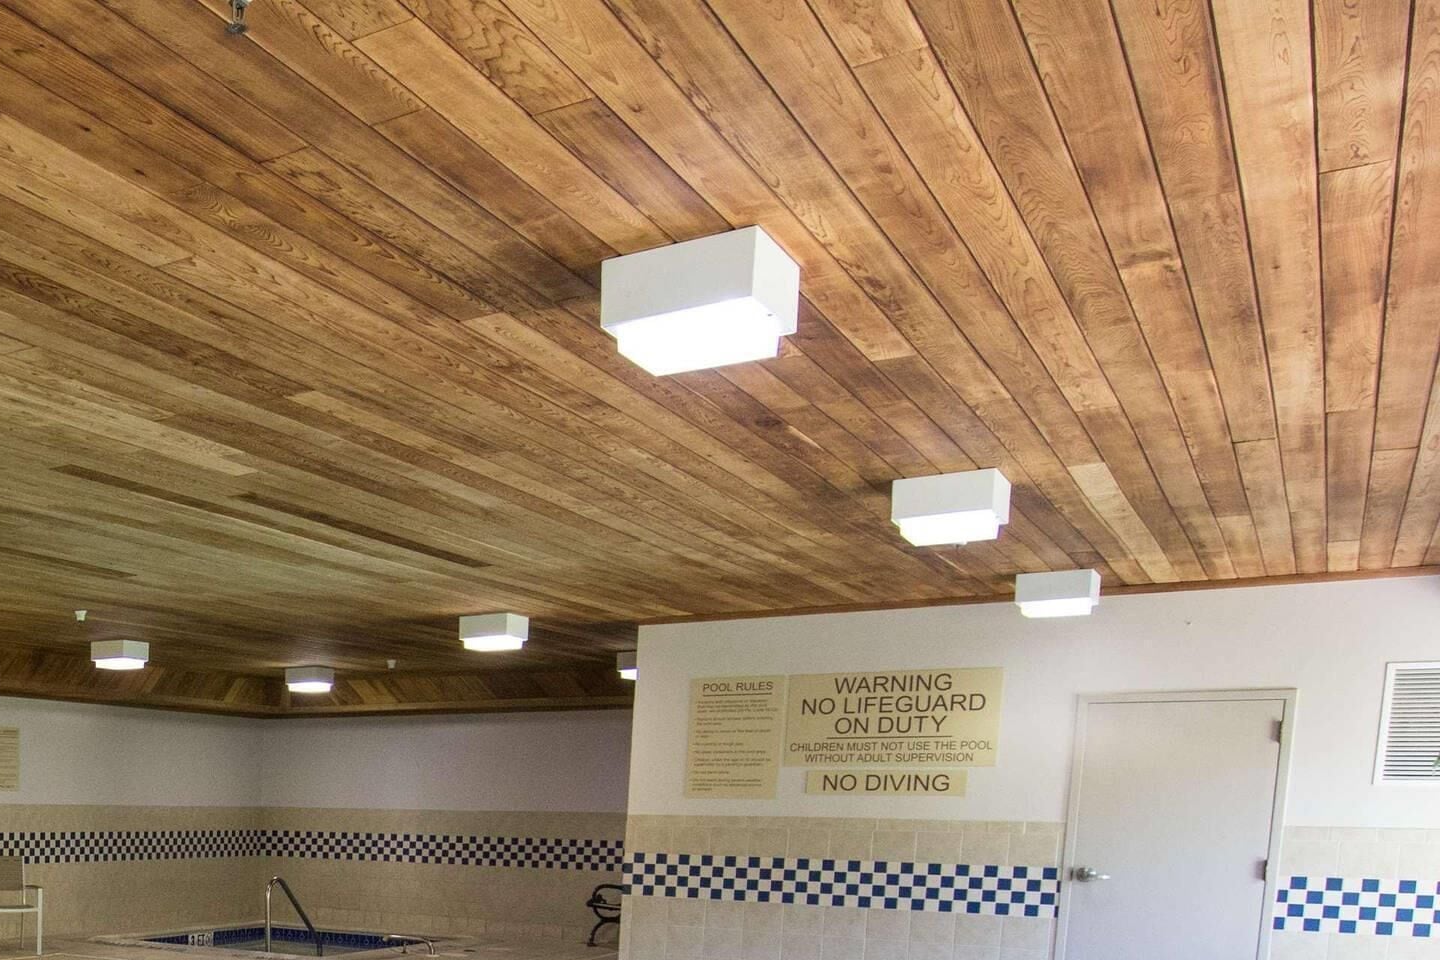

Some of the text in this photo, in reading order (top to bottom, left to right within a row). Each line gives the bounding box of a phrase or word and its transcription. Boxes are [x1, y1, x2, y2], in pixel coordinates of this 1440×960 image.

[702, 681, 774, 692] POOL RULES
[834, 673, 952, 694] WARNING
[802, 693, 986, 715] NO LIFEGUARD
[834, 715, 947, 734] ON DUTY
[790, 740, 992, 752] CHILDREN MUST NOT USE THE POOL
[804, 752, 974, 763] WITHOUT ADULT SUPERVISION
[822, 774, 950, 791] NO DIVING
